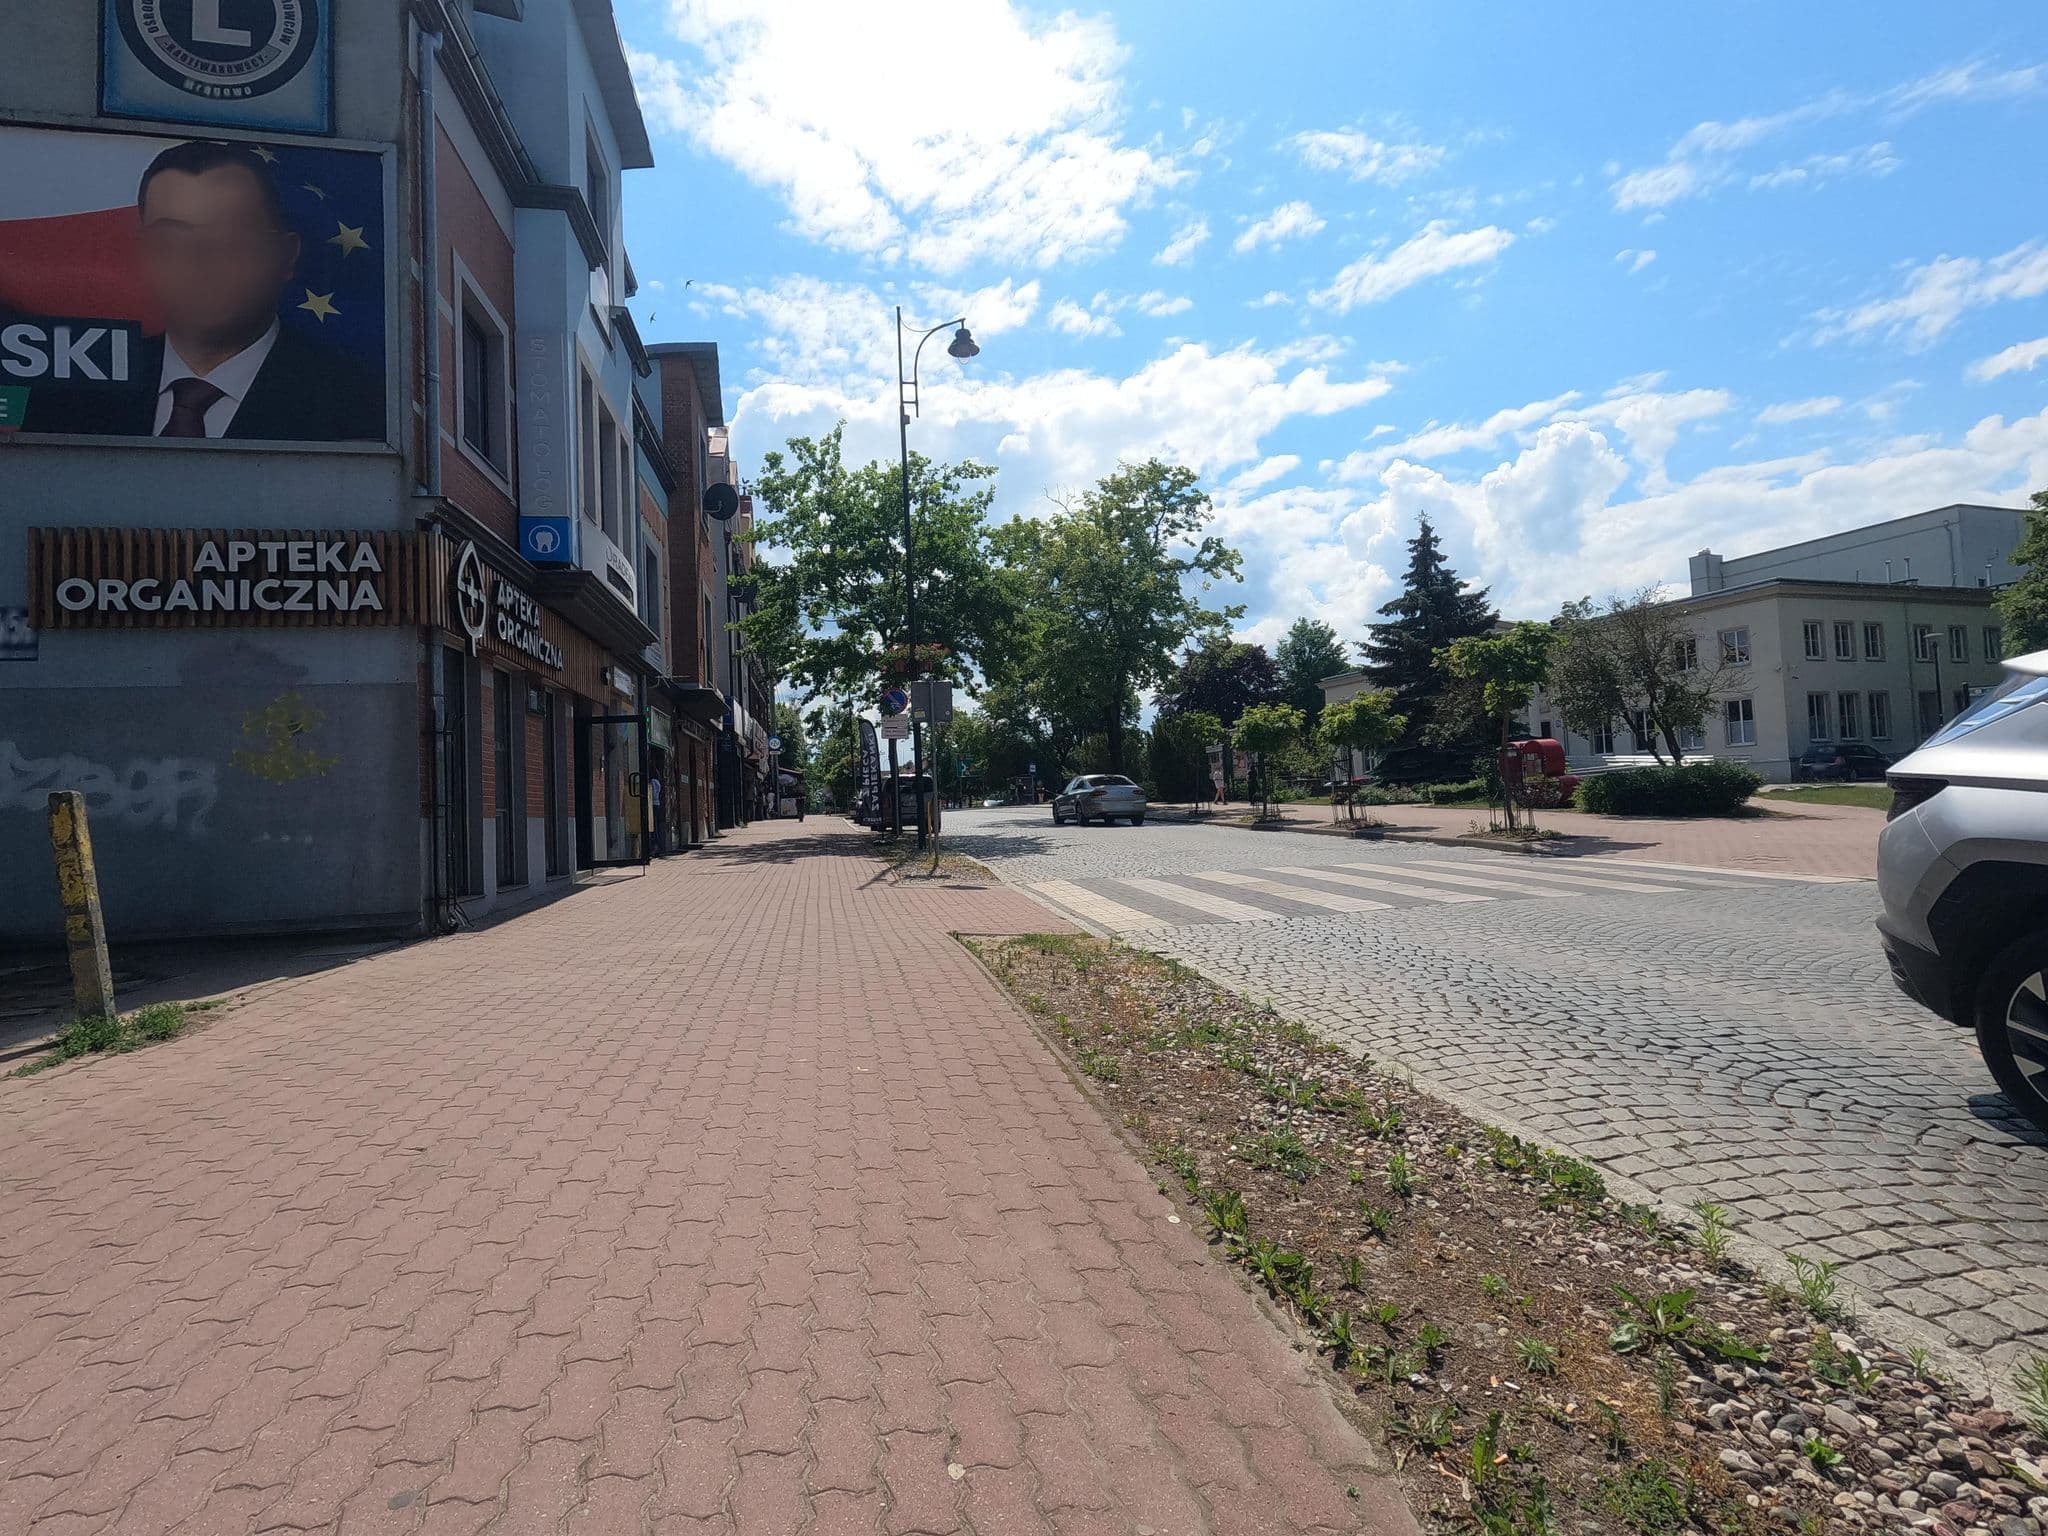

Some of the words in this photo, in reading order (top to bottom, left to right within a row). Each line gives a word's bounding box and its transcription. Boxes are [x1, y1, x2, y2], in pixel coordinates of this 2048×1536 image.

[1, 323, 128, 381] SKI
[529, 337, 551, 511] STOMATOLOG
[193, 541, 382, 572] APTEKA
[56, 577, 383, 611] ORGANICZNA
[497, 581, 540, 628] APTEKA
[497, 612, 565, 671] ORGANICZNA
